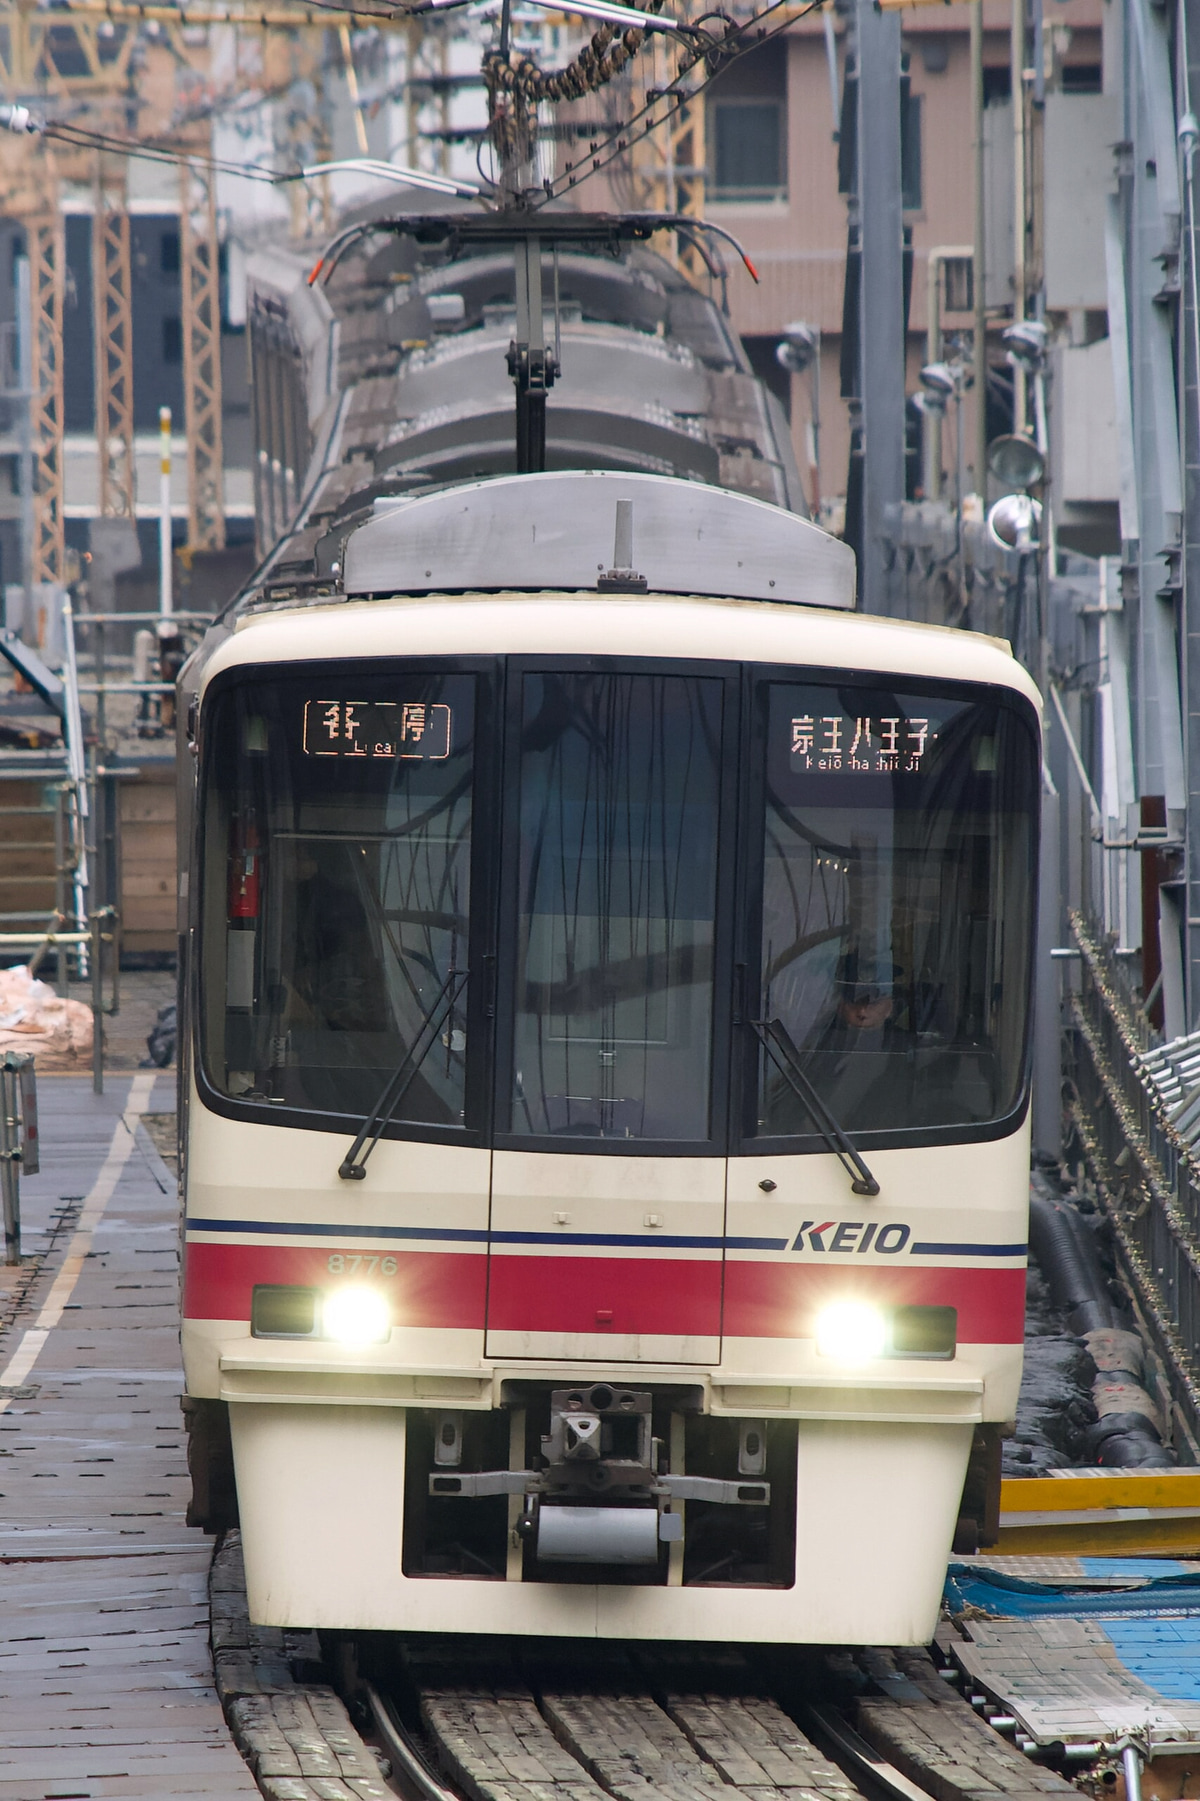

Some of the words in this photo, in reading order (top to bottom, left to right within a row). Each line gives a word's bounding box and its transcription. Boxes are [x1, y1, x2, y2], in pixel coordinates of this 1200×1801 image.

[791, 714, 938, 756] 京王八王子
[791, 1221, 911, 1254] KEIO
[327, 1253, 398, 1276] 8776
